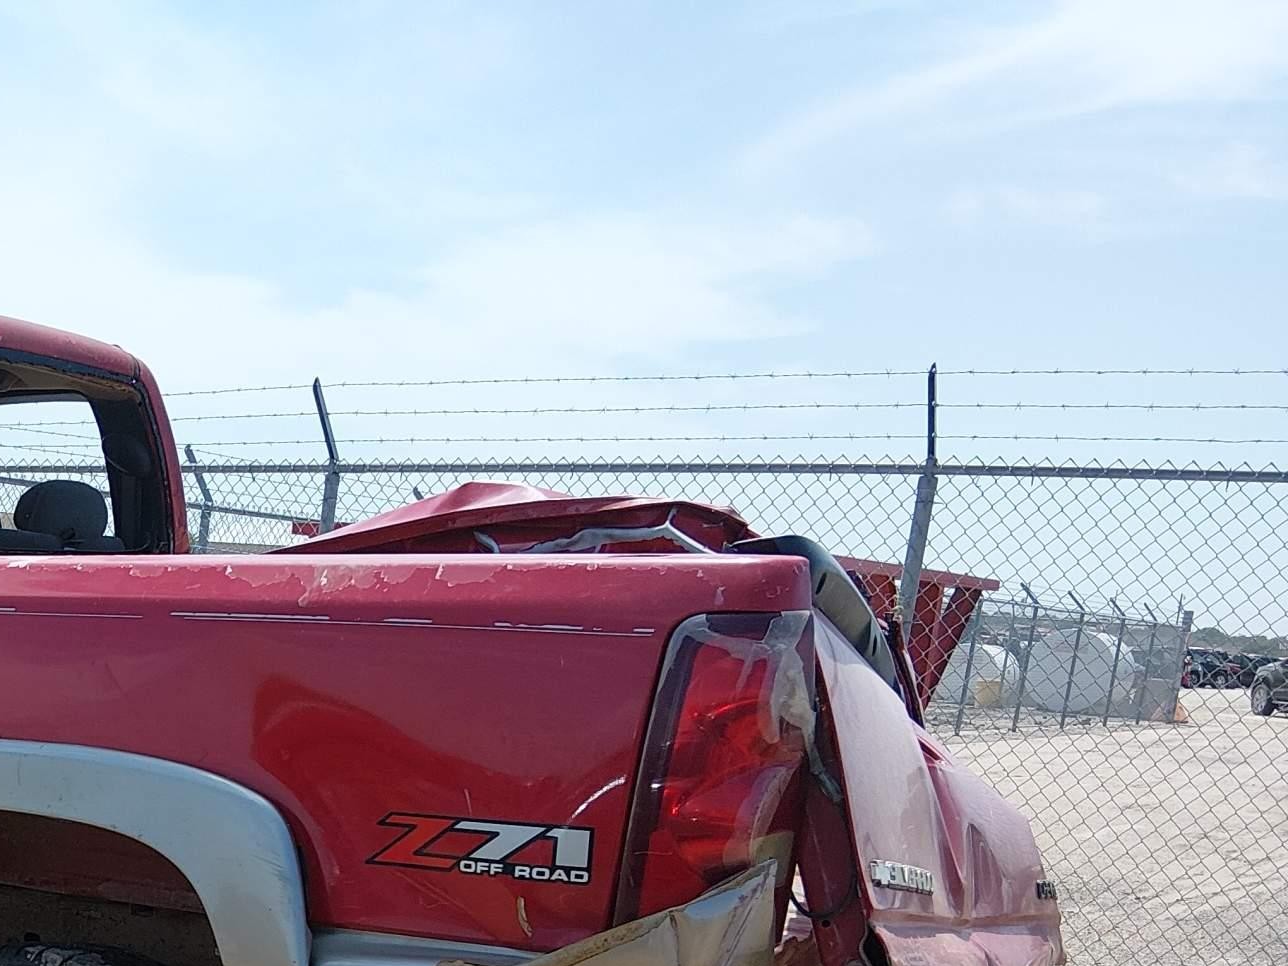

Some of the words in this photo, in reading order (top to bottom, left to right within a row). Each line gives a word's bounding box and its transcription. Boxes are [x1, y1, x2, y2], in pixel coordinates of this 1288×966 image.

[366, 811, 594, 872] Z71
[459, 860, 503, 876] OFF
[514, 866, 589, 883] ROAD
